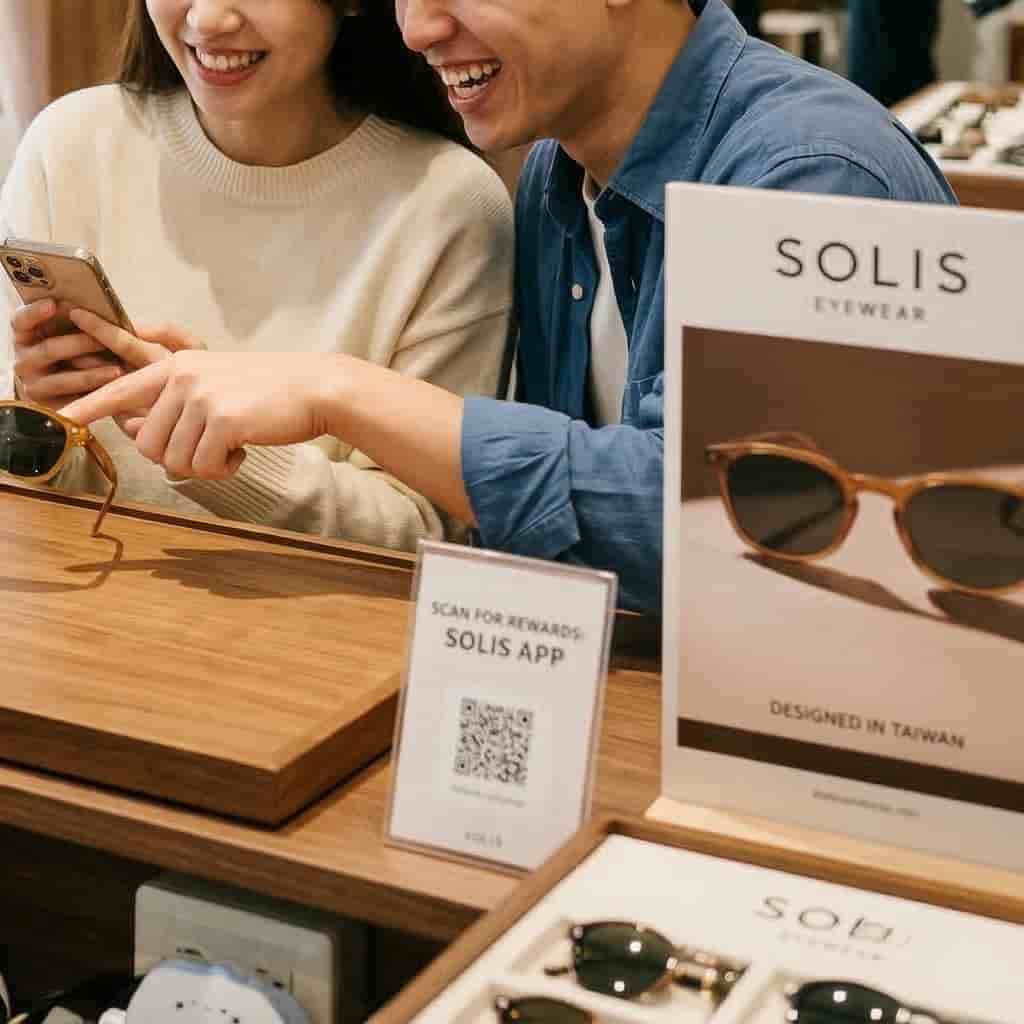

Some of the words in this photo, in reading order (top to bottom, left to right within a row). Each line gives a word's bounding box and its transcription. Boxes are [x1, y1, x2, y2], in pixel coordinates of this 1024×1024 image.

[774, 238, 967, 294] SOLIS
[814, 296, 927, 321] EYEWEAR
[431, 600, 470, 621] SCAN
[474, 608, 503, 625] FOR
[445, 627, 511, 657] SOLIS
[517, 640, 565, 666] APP
[769, 699, 863, 731] DESIGNED
[866, 718, 886, 736] IN
[891, 721, 965, 750] TAIWAN
